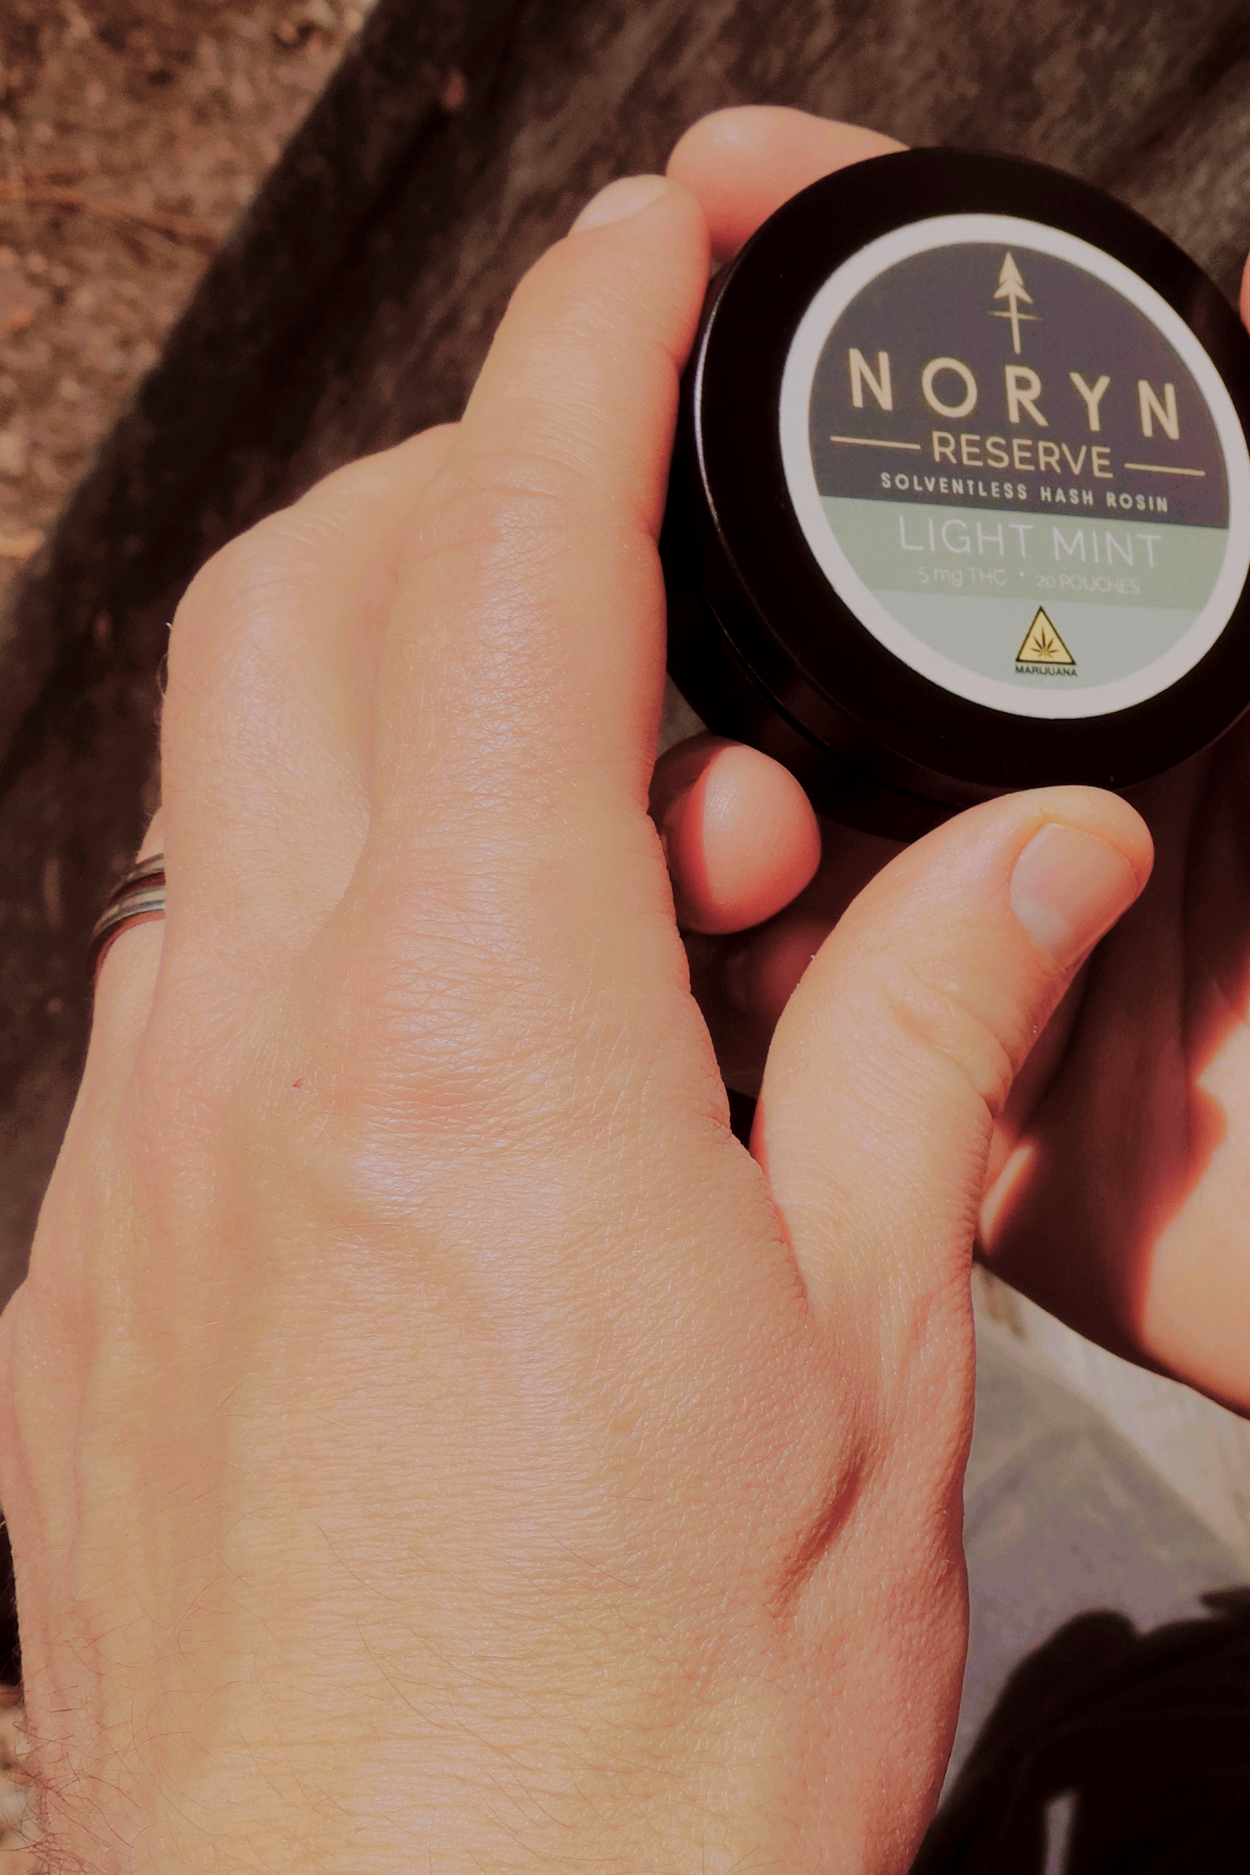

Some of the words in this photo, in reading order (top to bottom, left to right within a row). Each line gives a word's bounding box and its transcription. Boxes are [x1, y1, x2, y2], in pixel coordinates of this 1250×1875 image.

[848, 347, 1180, 440] NORYN
[932, 431, 1113, 478] RESERVE
[881, 472, 1028, 500] SOLVENTLESS
[1040, 485, 1094, 506] HASH
[1106, 491, 1168, 513] ROSIN
[898, 515, 1034, 558] LIGHT
[1053, 526, 1162, 567] MINT
[917, 566, 929, 583] 5
[933, 570, 962, 587] mg
[967, 566, 1007, 586] THC
[1036, 573, 1056, 589] 20
[1059, 574, 1141, 595] POUCHES
[1015, 665, 1078, 677] MARIJUANA
